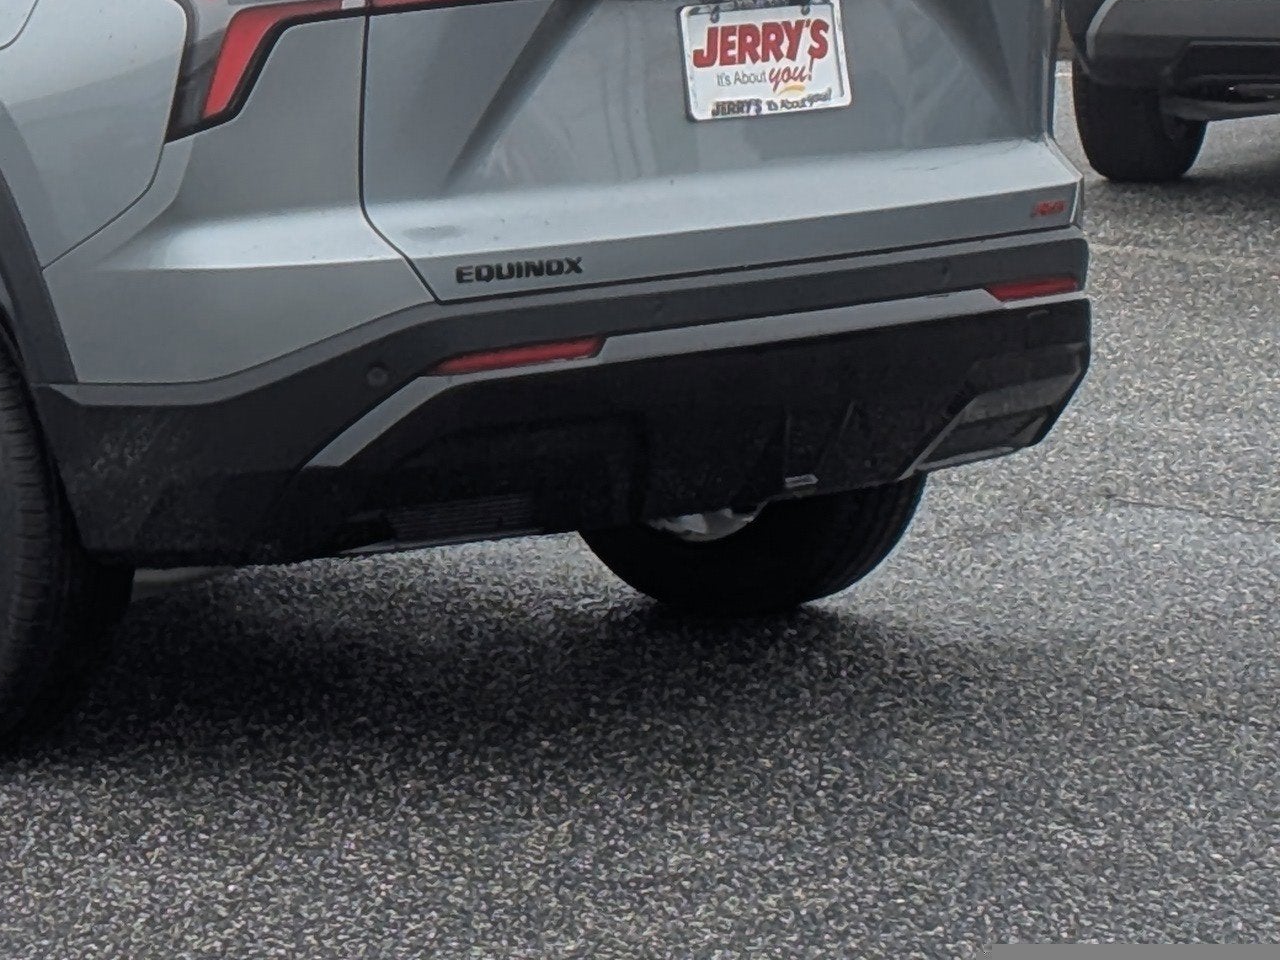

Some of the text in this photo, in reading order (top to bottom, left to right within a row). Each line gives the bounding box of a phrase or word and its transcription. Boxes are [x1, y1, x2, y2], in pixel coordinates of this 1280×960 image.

[693, 18, 829, 69] JERRY'S
[734, 69, 768, 85] About
[456, 256, 583, 284] EQUINOX
